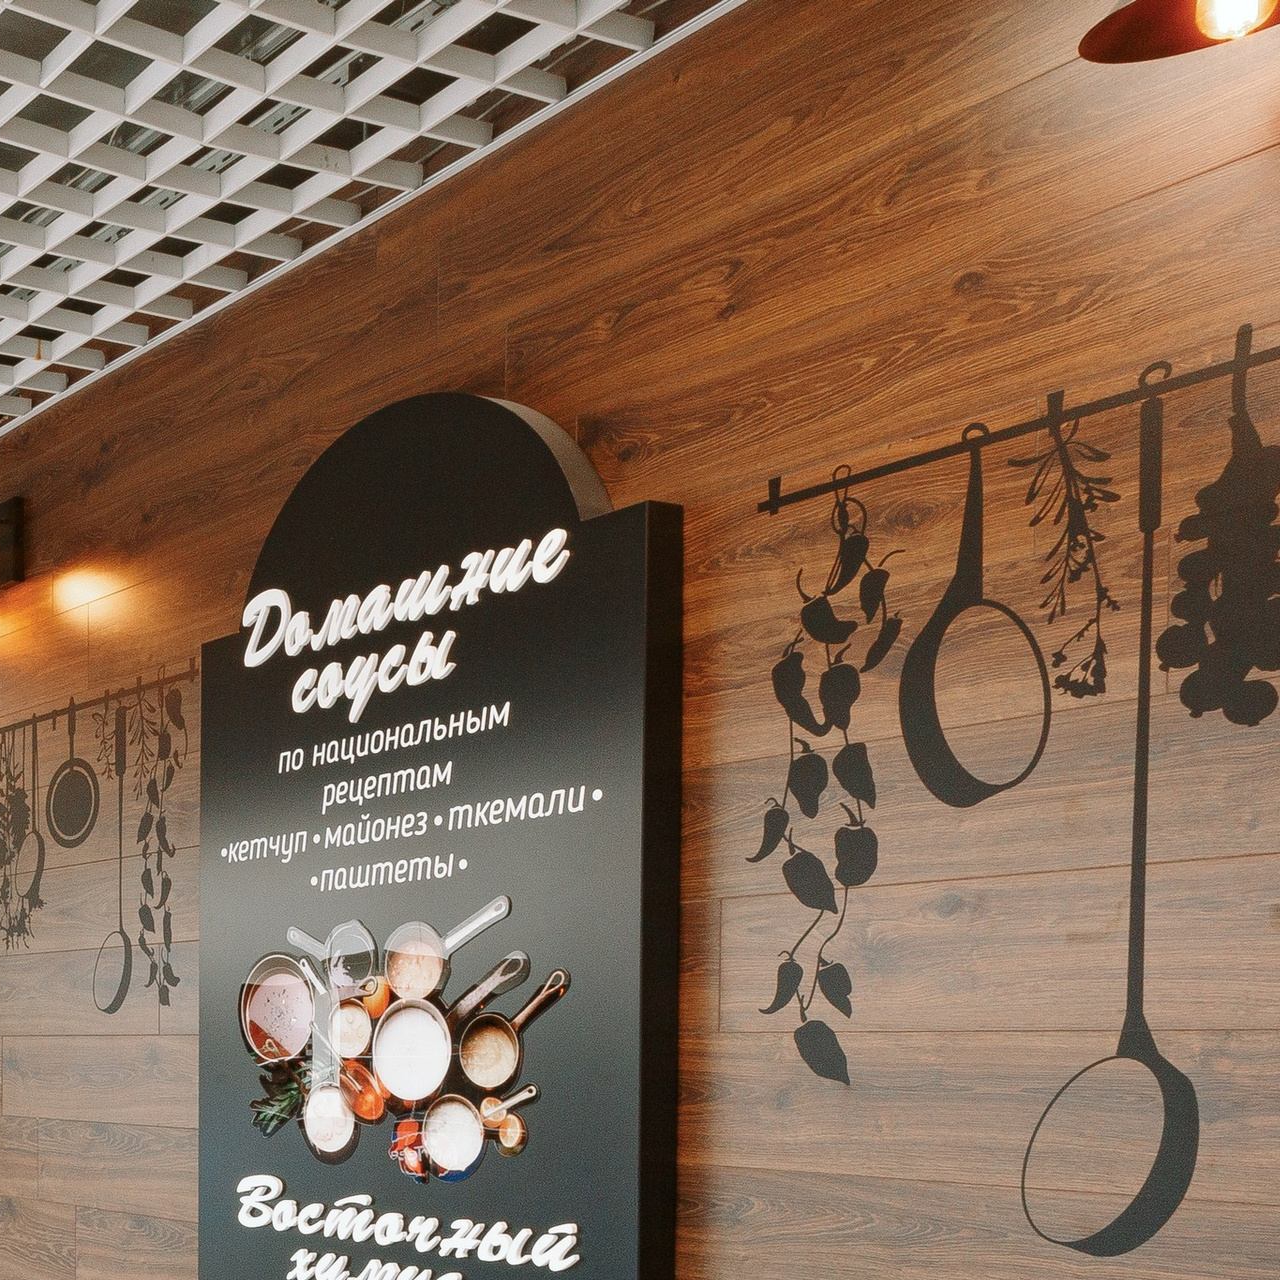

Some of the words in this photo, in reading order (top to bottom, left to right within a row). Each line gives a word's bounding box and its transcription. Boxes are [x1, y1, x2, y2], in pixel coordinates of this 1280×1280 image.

[242, 528, 570, 668] Домашние
[291, 630, 457, 723] соусы
[278, 746, 305, 775] по
[312, 701, 512, 767] национальным
[228, 829, 308, 864] кетчуп
[324, 811, 429, 849] майонез
[447, 784, 586, 831] ткемали
[320, 761, 453, 815] рецептам
[320, 853, 454, 892] паштеты
[235, 1173, 581, 1272] Восточный
